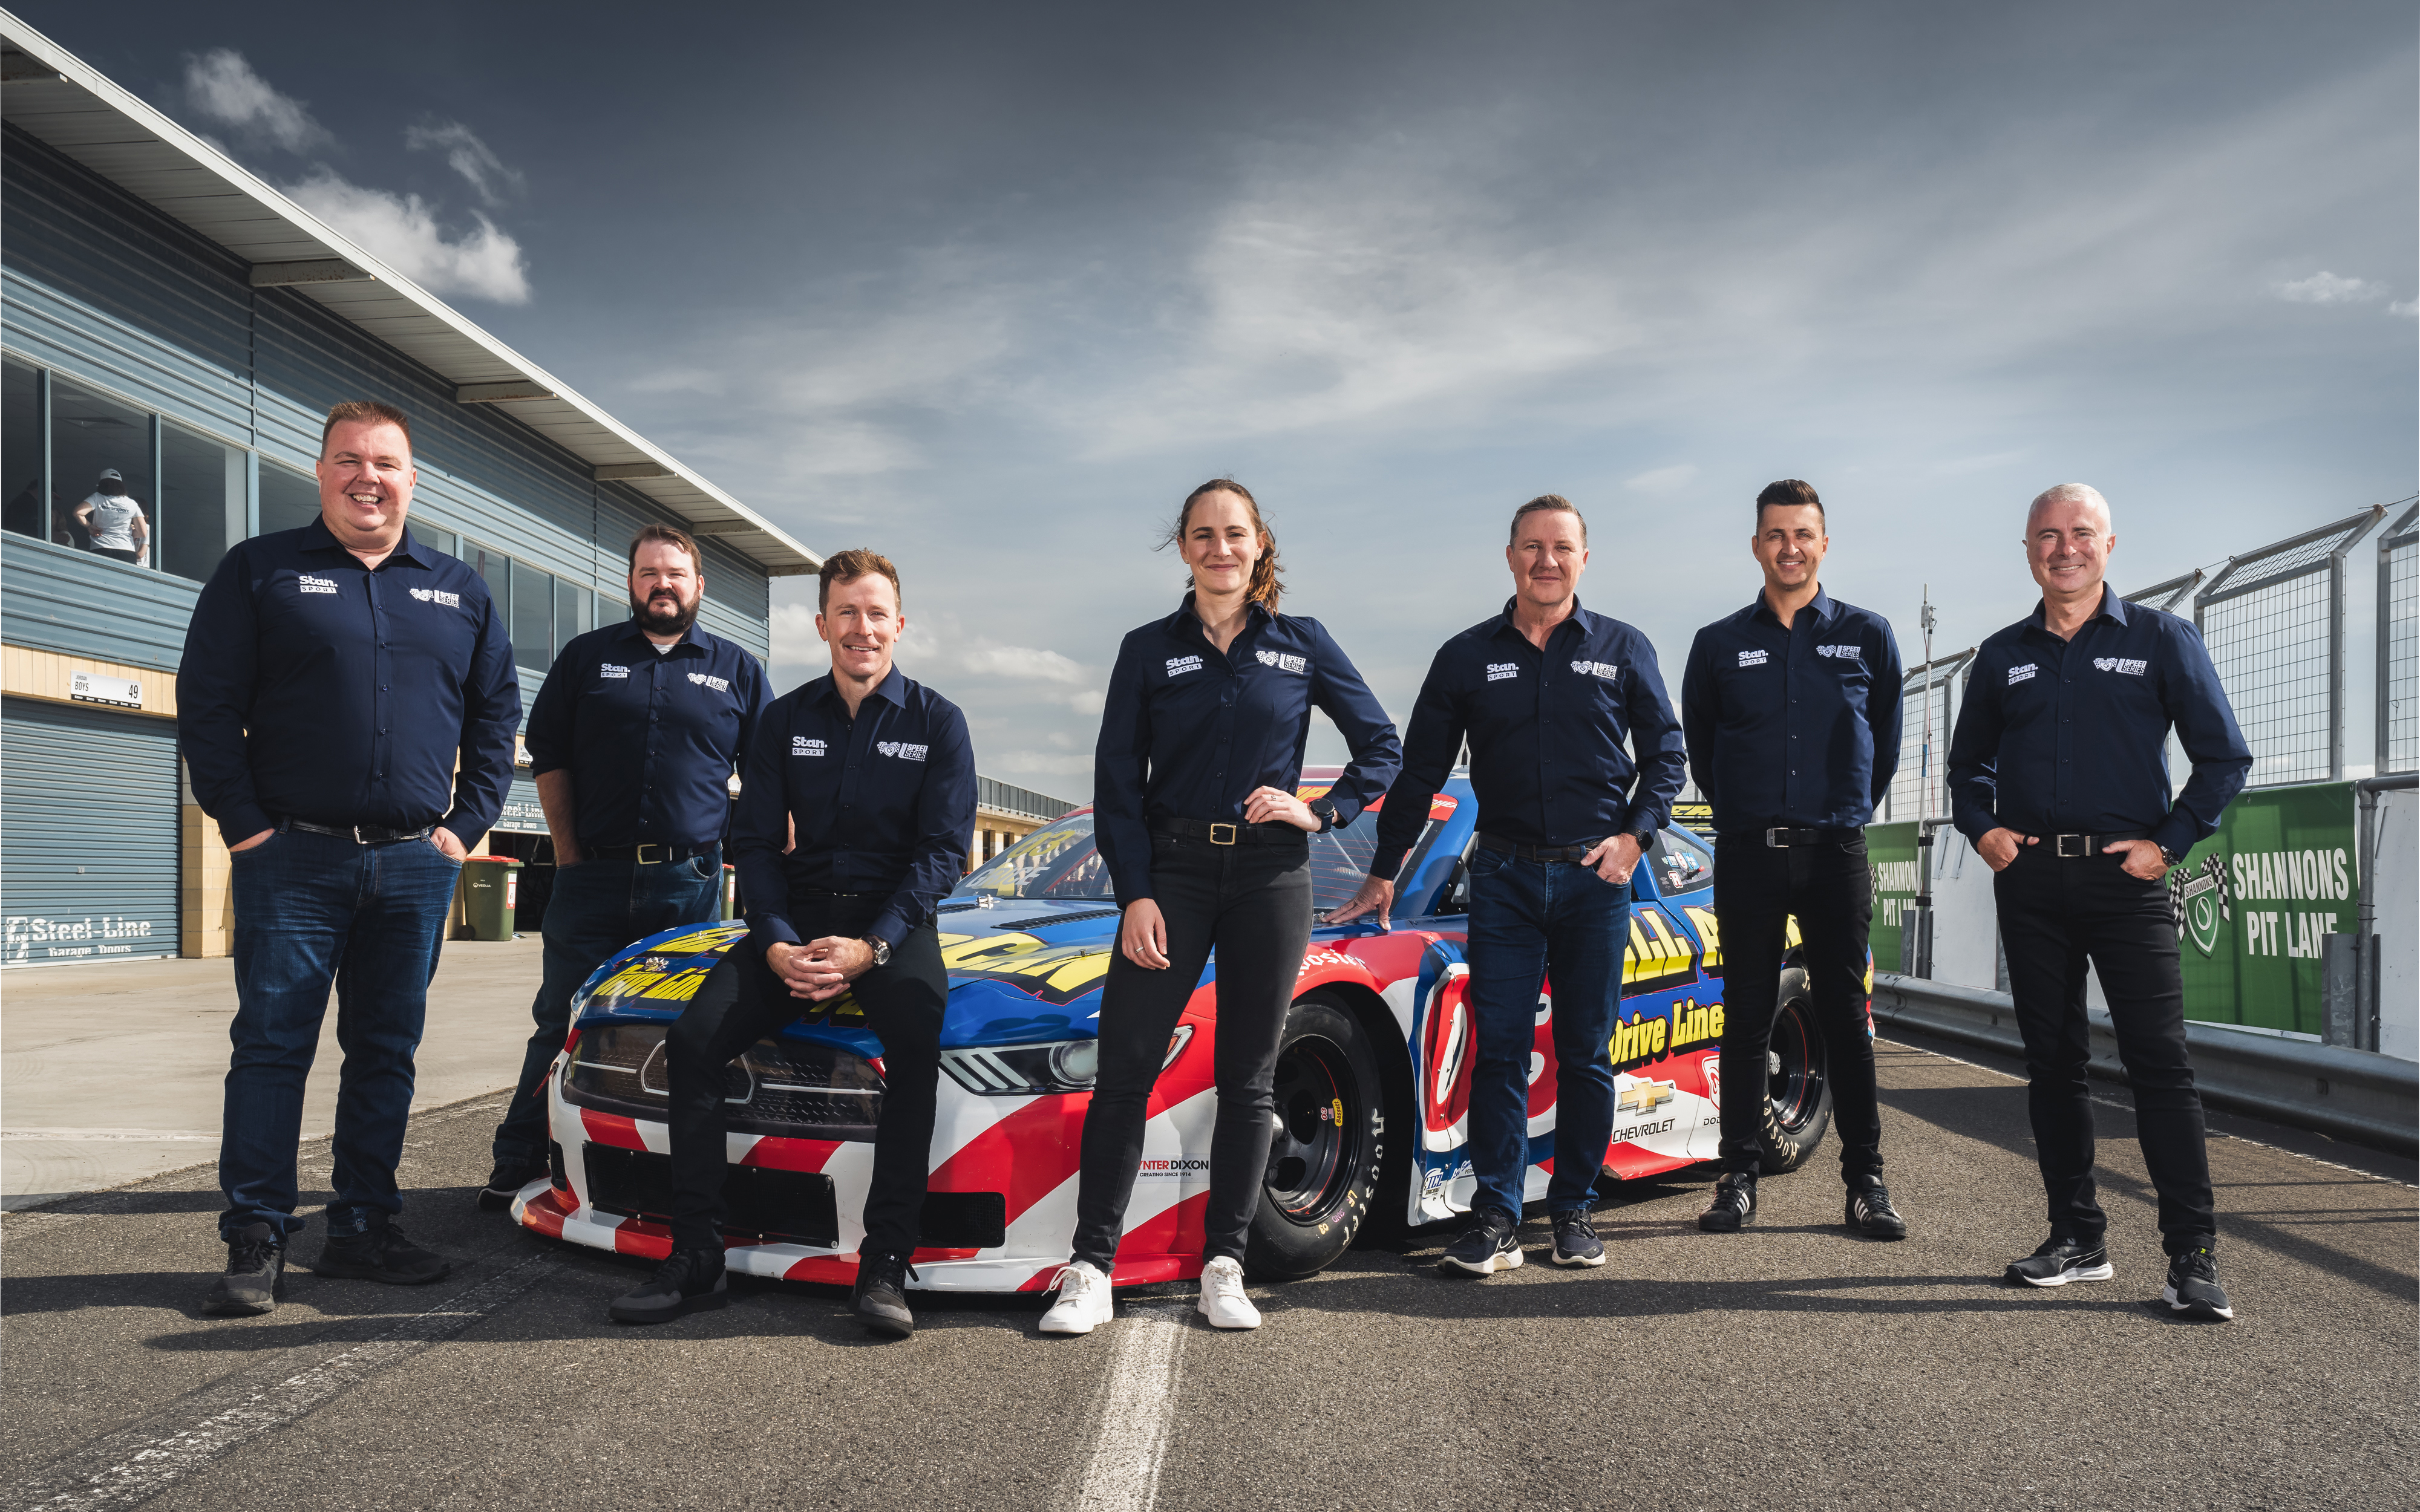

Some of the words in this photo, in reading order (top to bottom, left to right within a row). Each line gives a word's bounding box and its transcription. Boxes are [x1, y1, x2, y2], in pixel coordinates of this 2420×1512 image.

[440, 591, 459, 601] SPEED
[440, 597, 459, 606] SERIES
[1286, 654, 1306, 665] SPEED
[1740, 657, 1766, 666] SPORT
[2124, 659, 2147, 667] SPEED
[1169, 663, 1201, 676] SPORT
[1284, 661, 1304, 672] SERIES
[1599, 663, 1618, 672] SPEED
[2122, 665, 2145, 674] SERIES
[1488, 671, 1516, 680] SPORT
[1597, 668, 1616, 678] SERIES
[2009, 672, 2035, 684] SPORT
[712, 676, 729, 685] SPEED
[75, 682, 89, 691] BOYS
[128, 684, 138, 699] 49
[711, 682, 728, 691] SERIES
[904, 750, 926, 759] SERIES
[503, 820, 521, 830] Garage
[523, 820, 537, 829] Doors
[1007, 830, 1076, 858] 03
[965, 867, 1051, 888] GRICE
[1877, 861, 1922, 892] SHANNON
[2232, 847, 2349, 901] SHANNONS
[2185, 876, 2213, 898] SHANNONS
[1883, 899, 1895, 927] PIT
[30, 916, 151, 942] Steel-Line
[2246, 911, 2278, 956] PIT
[48, 947, 91, 957] Garage
[97, 945, 131, 954] Doors
[1609, 1013, 1666, 1066] Drive
[1612, 1118, 1675, 1142] CHEVROLET
[1171, 1160, 1209, 1170] DIXON
